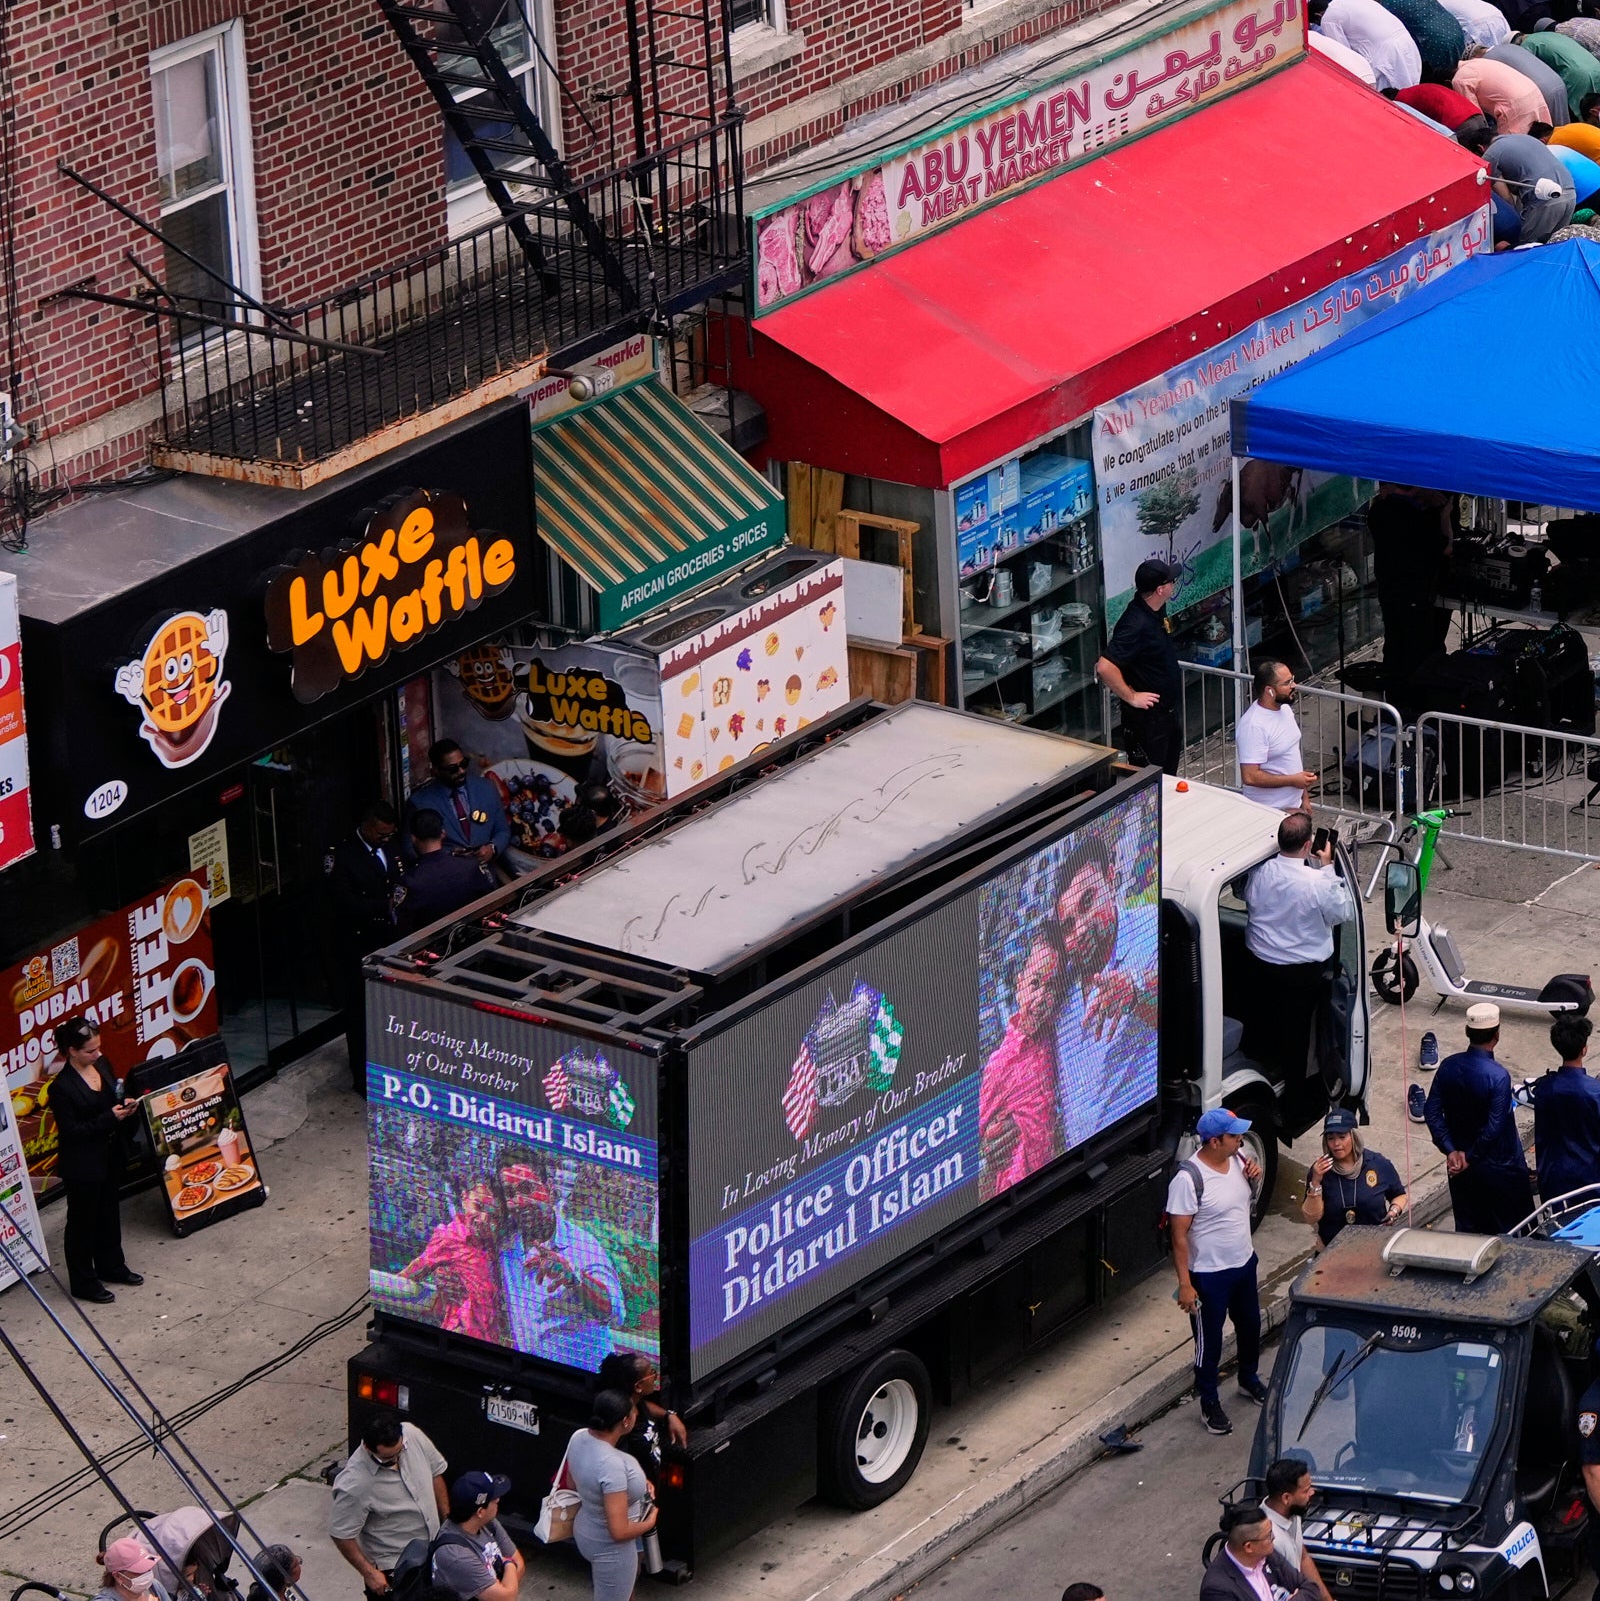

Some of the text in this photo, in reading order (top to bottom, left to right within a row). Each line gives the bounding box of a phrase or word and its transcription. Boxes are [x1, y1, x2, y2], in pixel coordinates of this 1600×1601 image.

[1104, 29, 1223, 112] يمن
[1145, 43, 1278, 120] ميت ماركت
[897, 79, 1092, 209] ABU YEMEN
[920, 131, 1073, 227] MEAT MARKET
[1365, 262, 1411, 302] ميت
[1414, 240, 1452, 282] يمن
[1302, 285, 1363, 334] ماركت
[1100, 408, 1135, 437] Abu
[1138, 376, 1196, 419] Yemen
[1197, 350, 1238, 390] Meat
[1240, 318, 1296, 367] Market
[1102, 404, 1220, 472] We congratulate you on the
[1113, 480, 1126, 498] we
[1129, 462, 1177, 491] announce
[1178, 447, 1196, 471] that
[1197, 444, 1210, 460] we
[1211, 429, 1232, 453] have
[288, 506, 435, 647] Luxe
[620, 521, 768, 612] AFRICAN GROCERIES SPICES
[330, 536, 516, 674] Waffle
[528, 663, 608, 701] Luxe
[550, 696, 651, 742] Waffle
[0, 777, 13, 798] ES
[90, 787, 122, 814] 1204
[19, 978, 90, 1036] DUBAI
[24, 981, 50, 1001] Waffle
[27, 975, 46, 990] Luxe
[128, 911, 145, 1046] WE MAKE IT WITH LOVE
[384, 1013, 534, 1076] In Loving Memory
[406, 1050, 520, 1094] of Our Brother
[161, 1095, 222, 1126] Cool Down with
[162, 1109, 210, 1135] Luxe Waffle
[165, 1125, 198, 1145] Delights
[382, 1073, 642, 1169] P.O. Didarul Islam
[721, 1051, 967, 1211] In Loving Memory of Our Brother
[723, 1102, 964, 1273] Police Officer
[721, 1151, 965, 1323] Didarul Islam
[1391, 1325, 1417, 1339] 9508
[1505, 1527, 1536, 1562] POLICE
